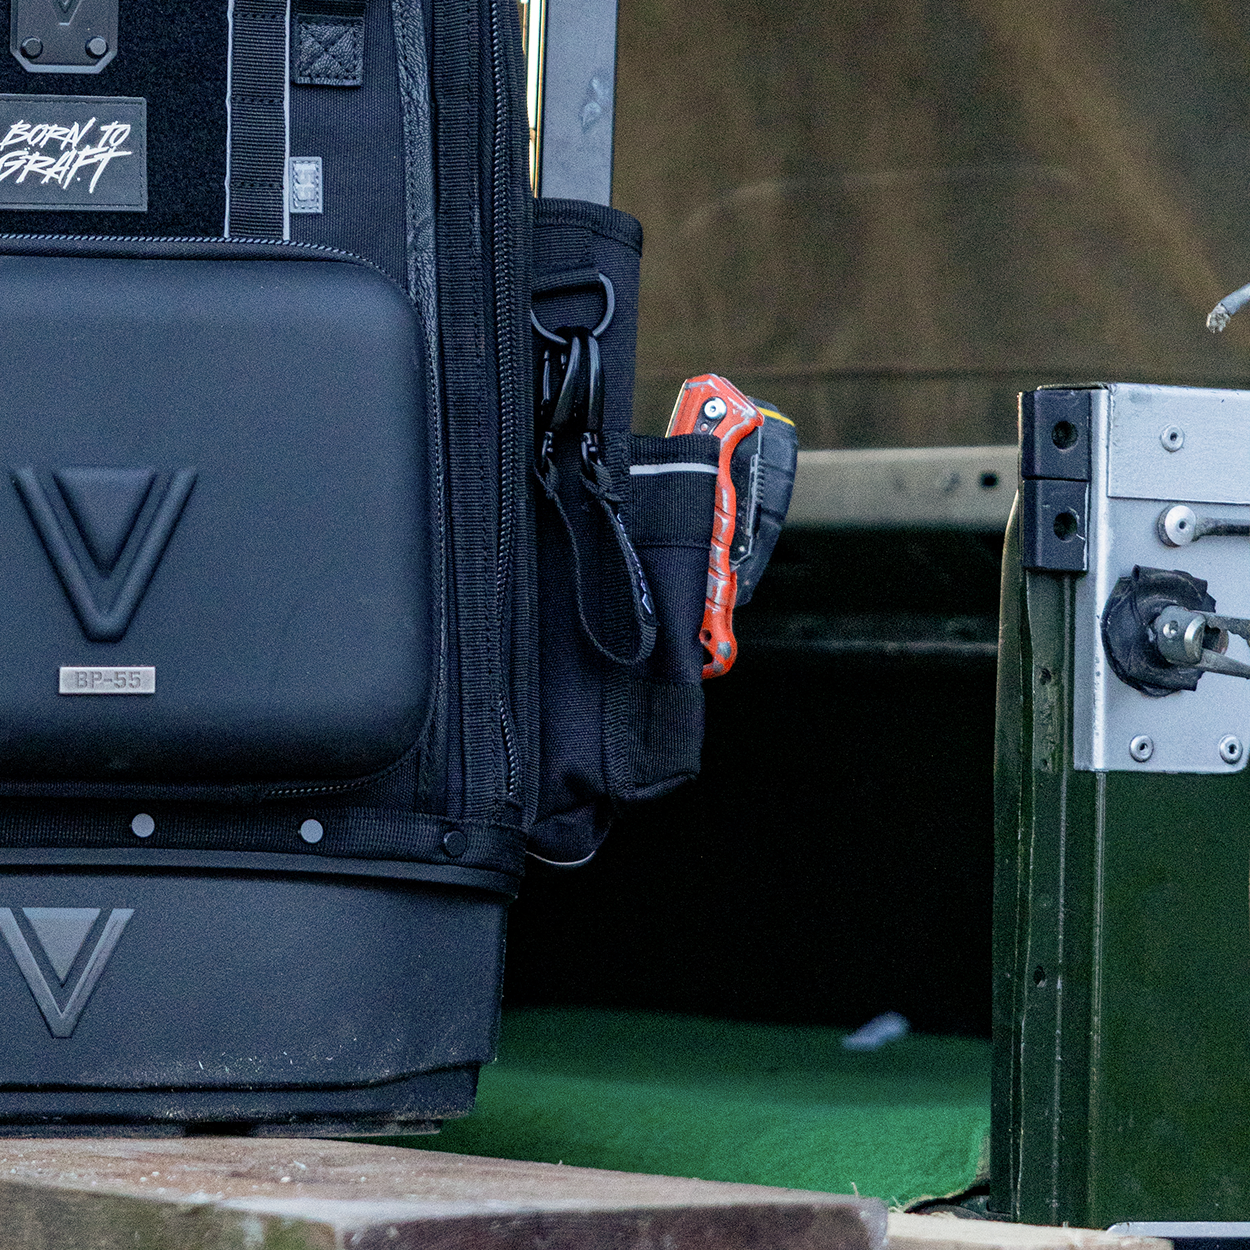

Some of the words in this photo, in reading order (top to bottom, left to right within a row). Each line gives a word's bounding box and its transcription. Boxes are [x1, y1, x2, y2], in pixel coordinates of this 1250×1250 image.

[0, 117, 96, 150] BORN
[98, 121, 131, 148] TO
[75, 671, 141, 689] BP-55
